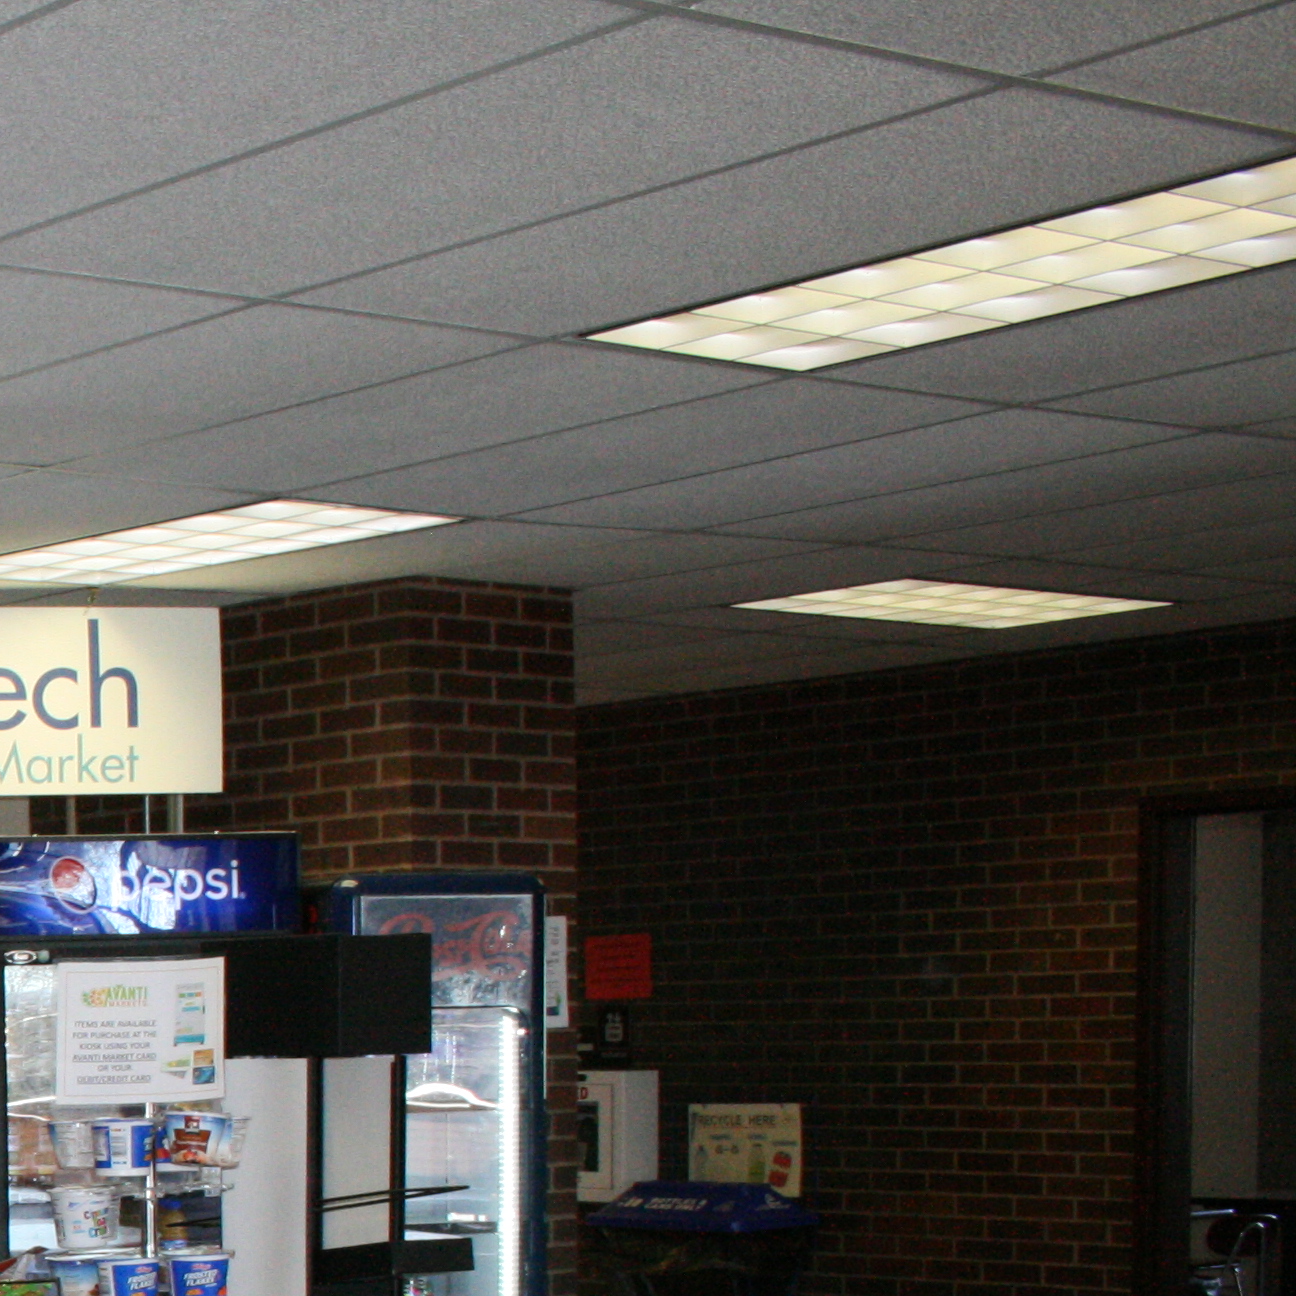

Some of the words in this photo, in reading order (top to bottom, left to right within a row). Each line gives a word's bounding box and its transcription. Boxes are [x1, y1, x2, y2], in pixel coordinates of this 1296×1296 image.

[113, 861, 240, 911] pepsi
[108, 984, 148, 1000] AVANTI
[90, 1031, 131, 1039] PURCHASE
[130, 1042, 151, 1050] YOUR
[111, 1064, 132, 1072] YOUR
[748, 1114, 777, 1126] HERE
